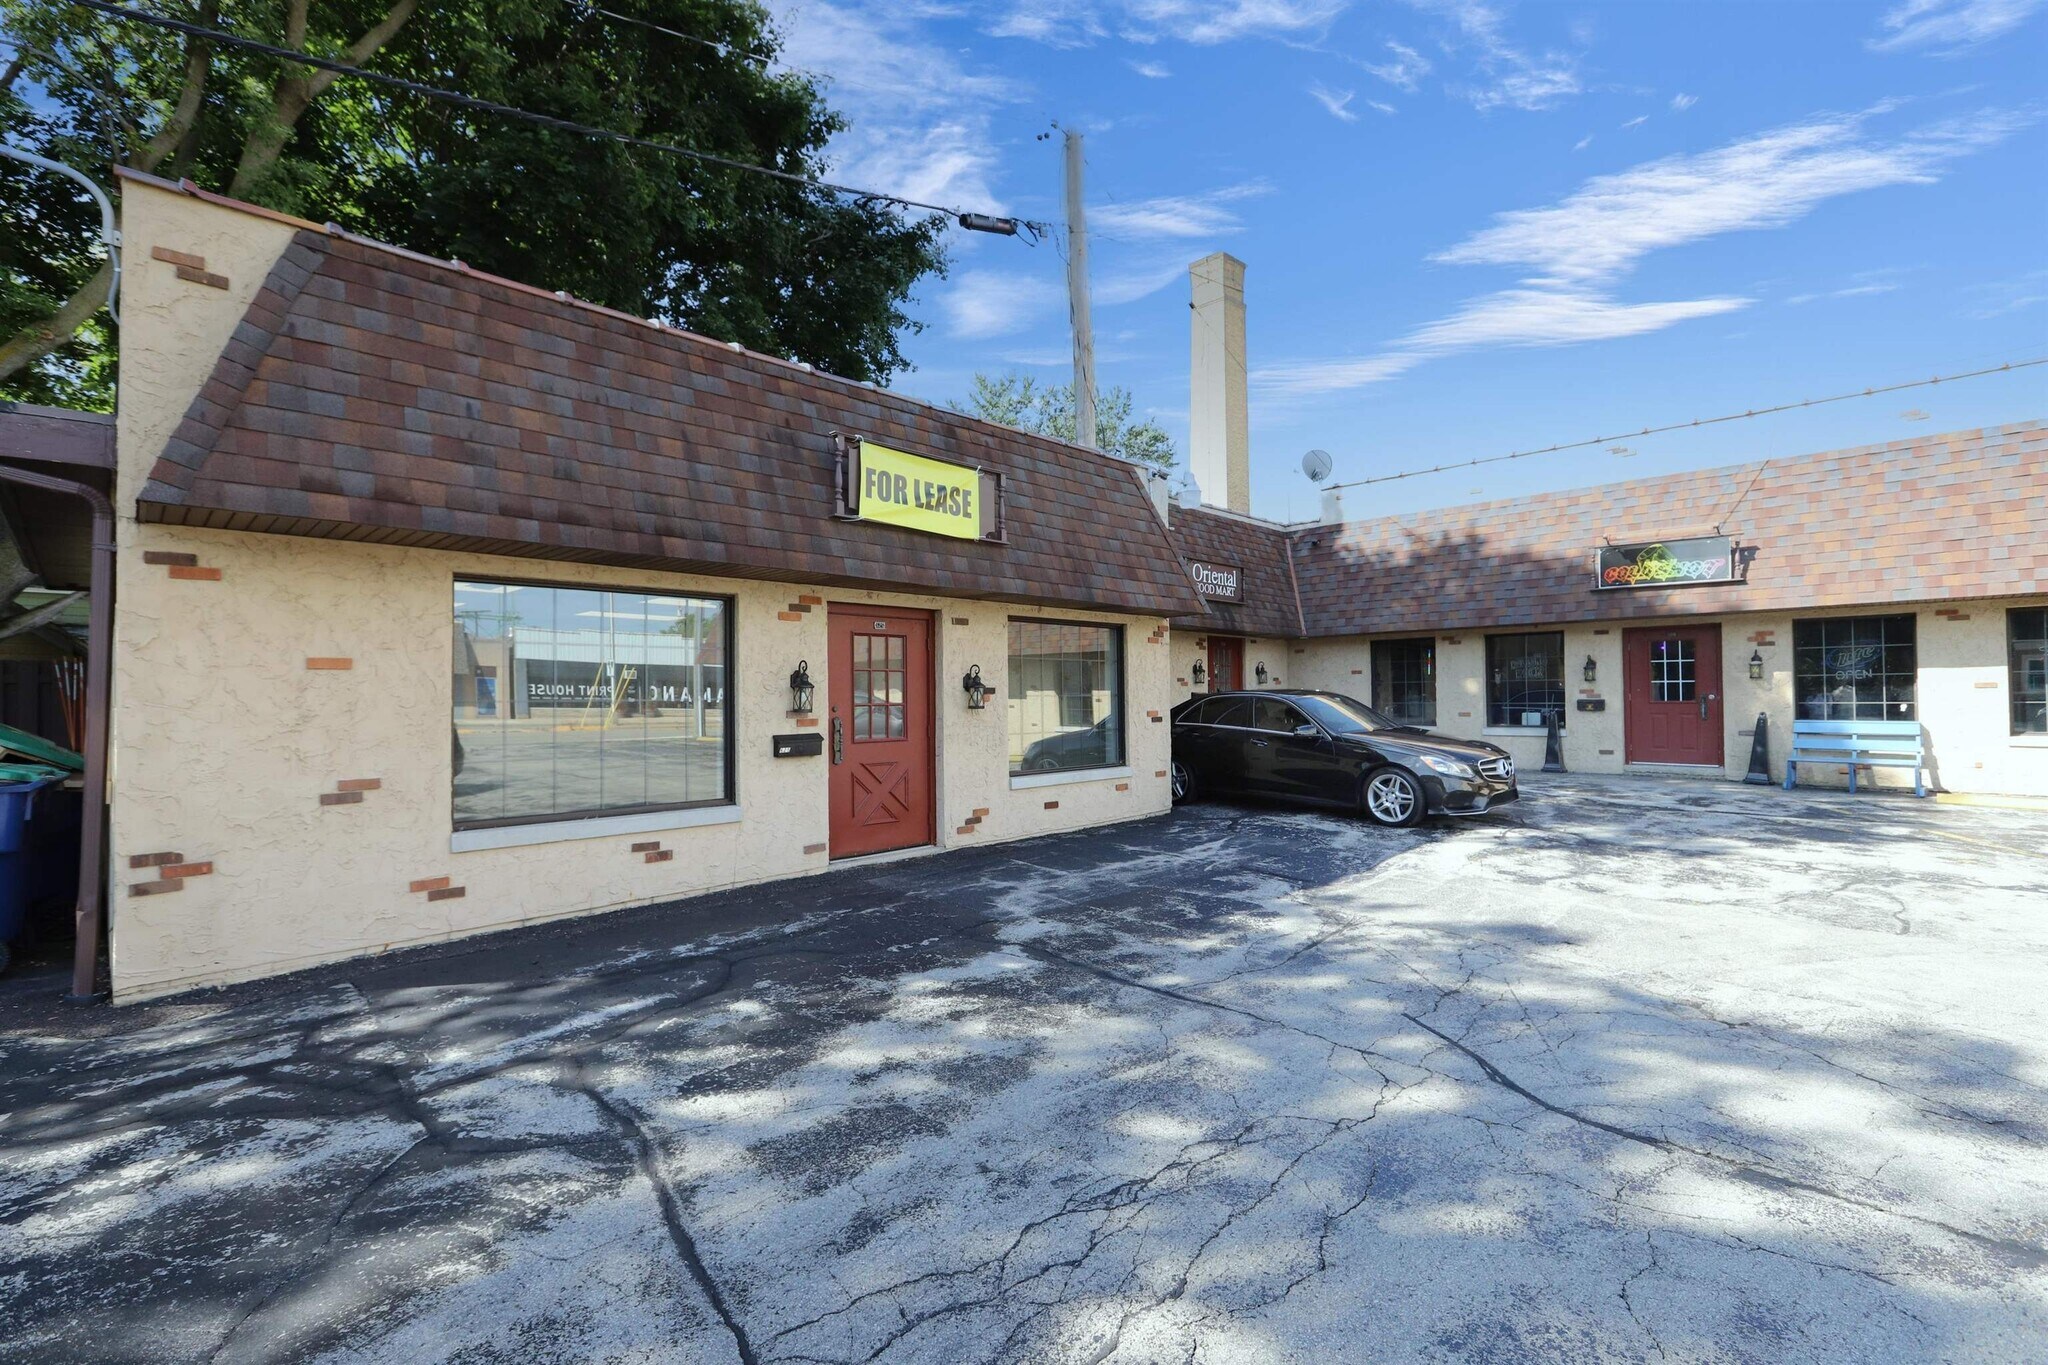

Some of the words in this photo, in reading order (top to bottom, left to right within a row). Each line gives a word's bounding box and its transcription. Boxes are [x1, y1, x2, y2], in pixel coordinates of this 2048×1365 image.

[866, 467, 908, 505] FOR
[914, 478, 972, 519] LEASE
[1192, 563, 1237, 587] Oriental
[1197, 583, 1215, 594] OOD
[1216, 586, 1235, 597] MART
[1835, 669, 1873, 680] OPEN
